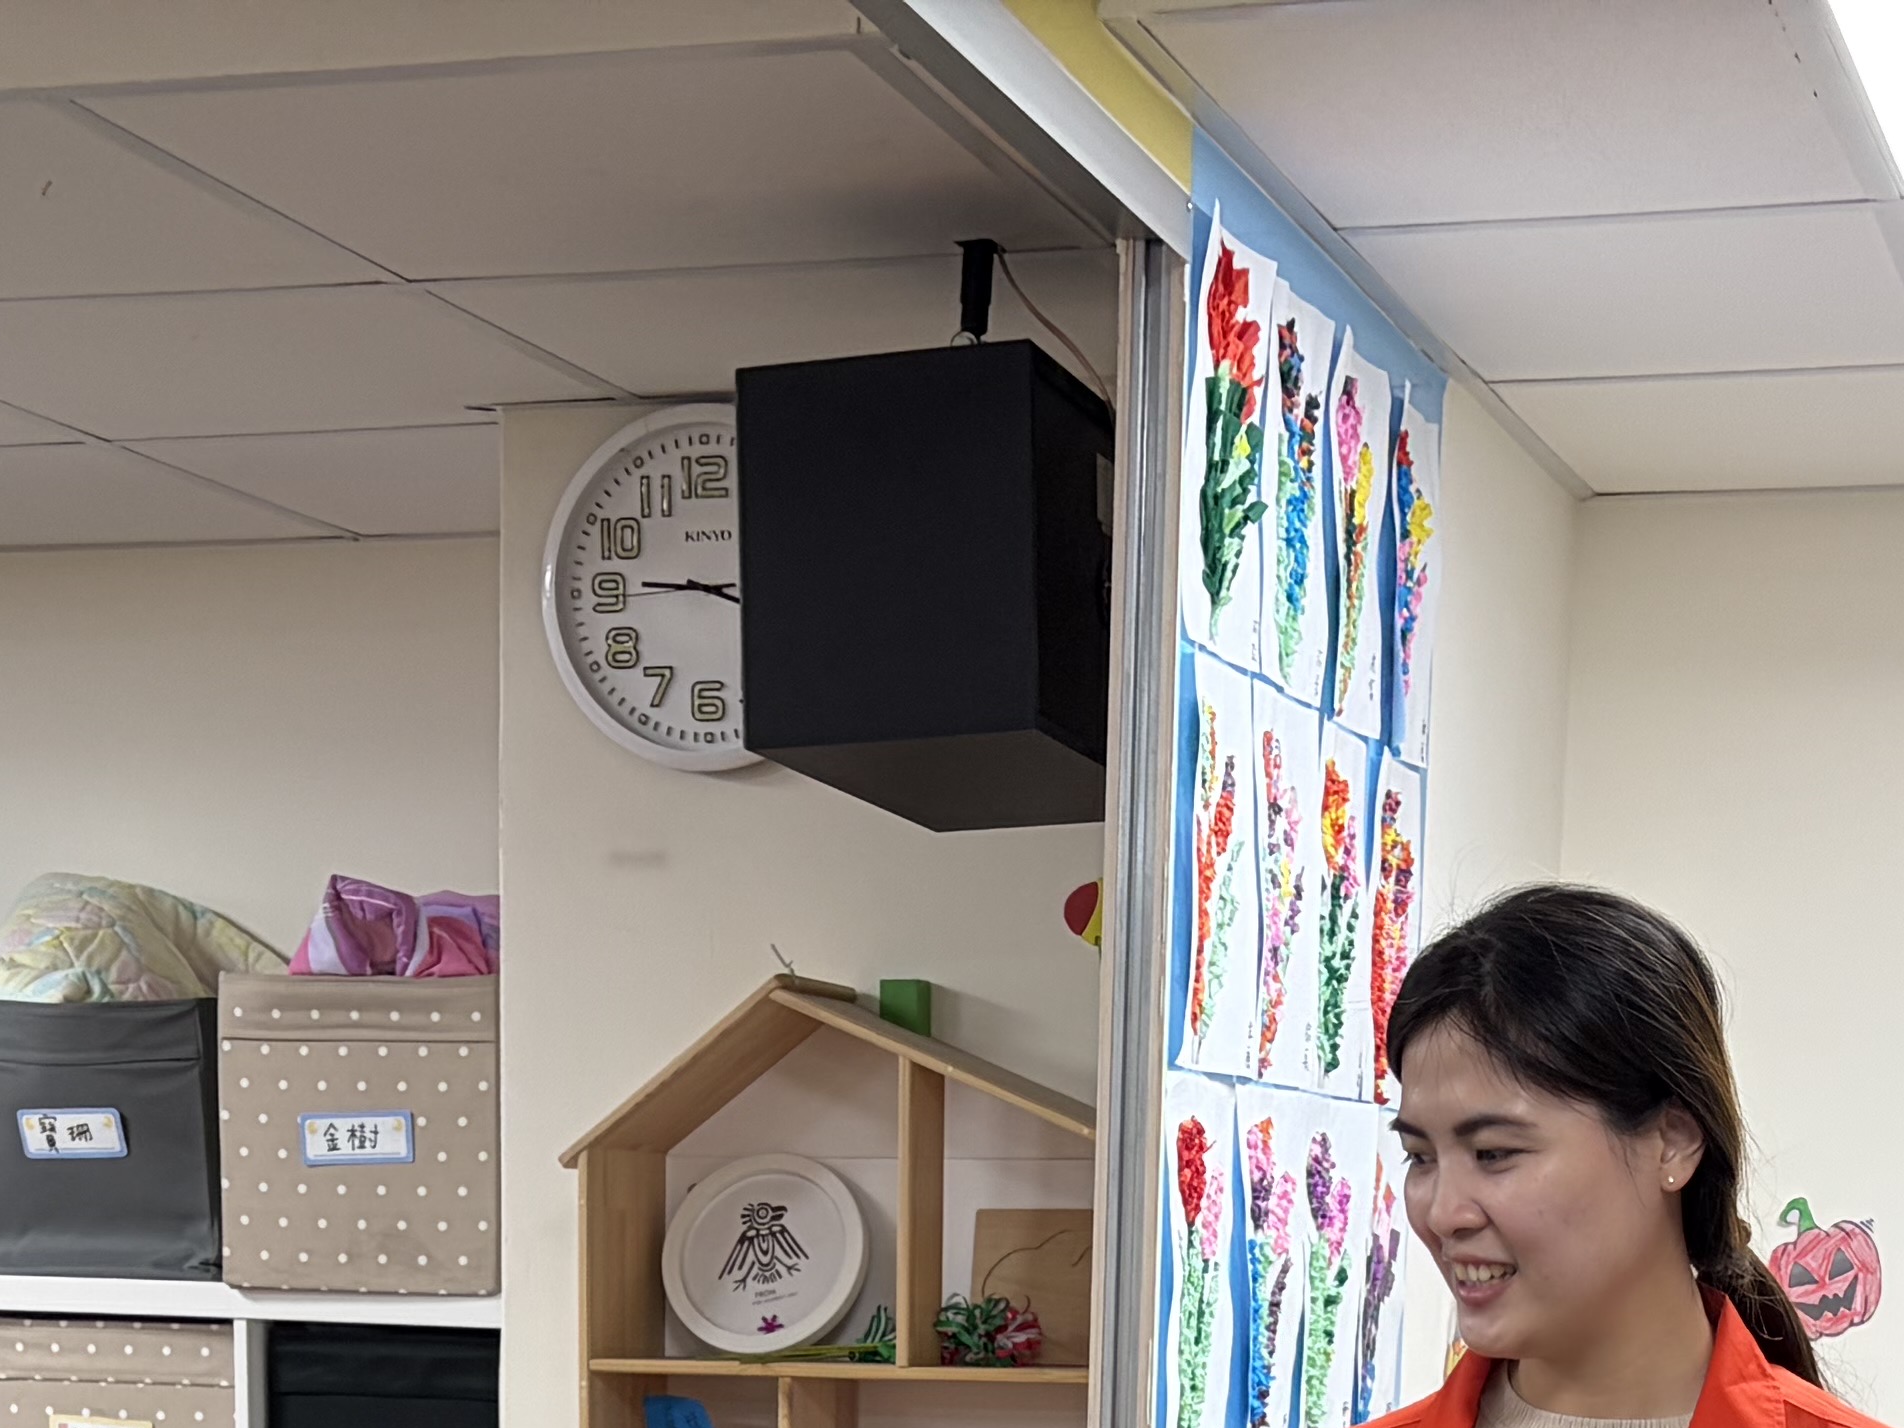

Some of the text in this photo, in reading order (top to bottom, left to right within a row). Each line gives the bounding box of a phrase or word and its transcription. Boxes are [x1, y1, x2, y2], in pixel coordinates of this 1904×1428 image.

[640, 475, 673, 518] 11
[681, 455, 730, 499] 12
[600, 517, 641, 560] 10
[684, 530, 733, 543] KINYO
[592, 571, 627, 613] 9
[605, 627, 640, 669] 8
[643, 666, 675, 708] 7
[691, 680, 726, 722] 6
[38, 1114, 93, 1154] 寶珊
[323, 1122, 380, 1152] 金樹
